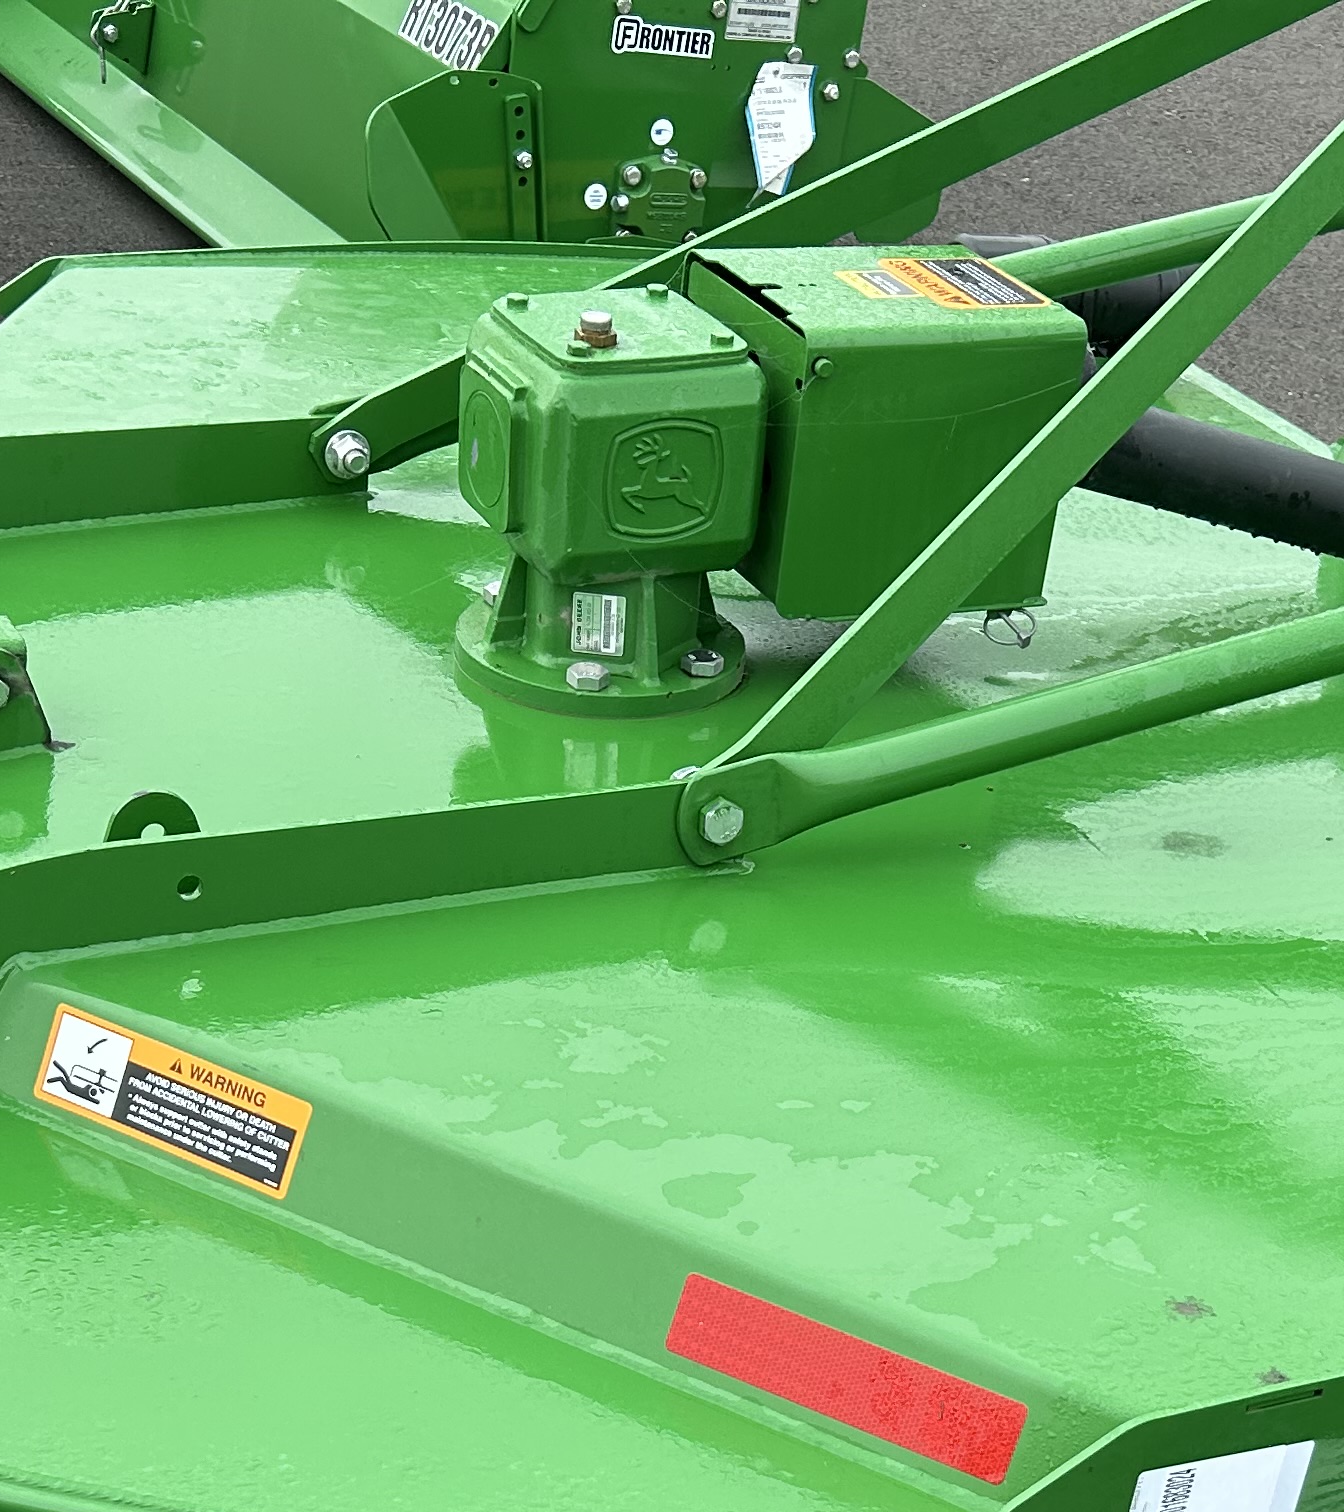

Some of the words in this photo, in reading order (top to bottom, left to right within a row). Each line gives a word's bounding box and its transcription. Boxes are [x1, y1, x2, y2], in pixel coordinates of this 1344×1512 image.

[614, 18, 712, 55] FRONTIER
[144, 1071, 171, 1090] AVOID
[169, 1081, 207, 1104] SERIOUS
[234, 1108, 249, 1122] OR
[247, 1113, 277, 1134] DEATH
[189, 1064, 267, 1108] WARNING
[127, 1075, 153, 1094] FROM
[150, 1085, 202, 1114] ACCIDENTAL
[199, 1105, 245, 1132] LOWERING
[243, 1123, 257, 1138] OF
[255, 1129, 291, 1151] CUTTER
